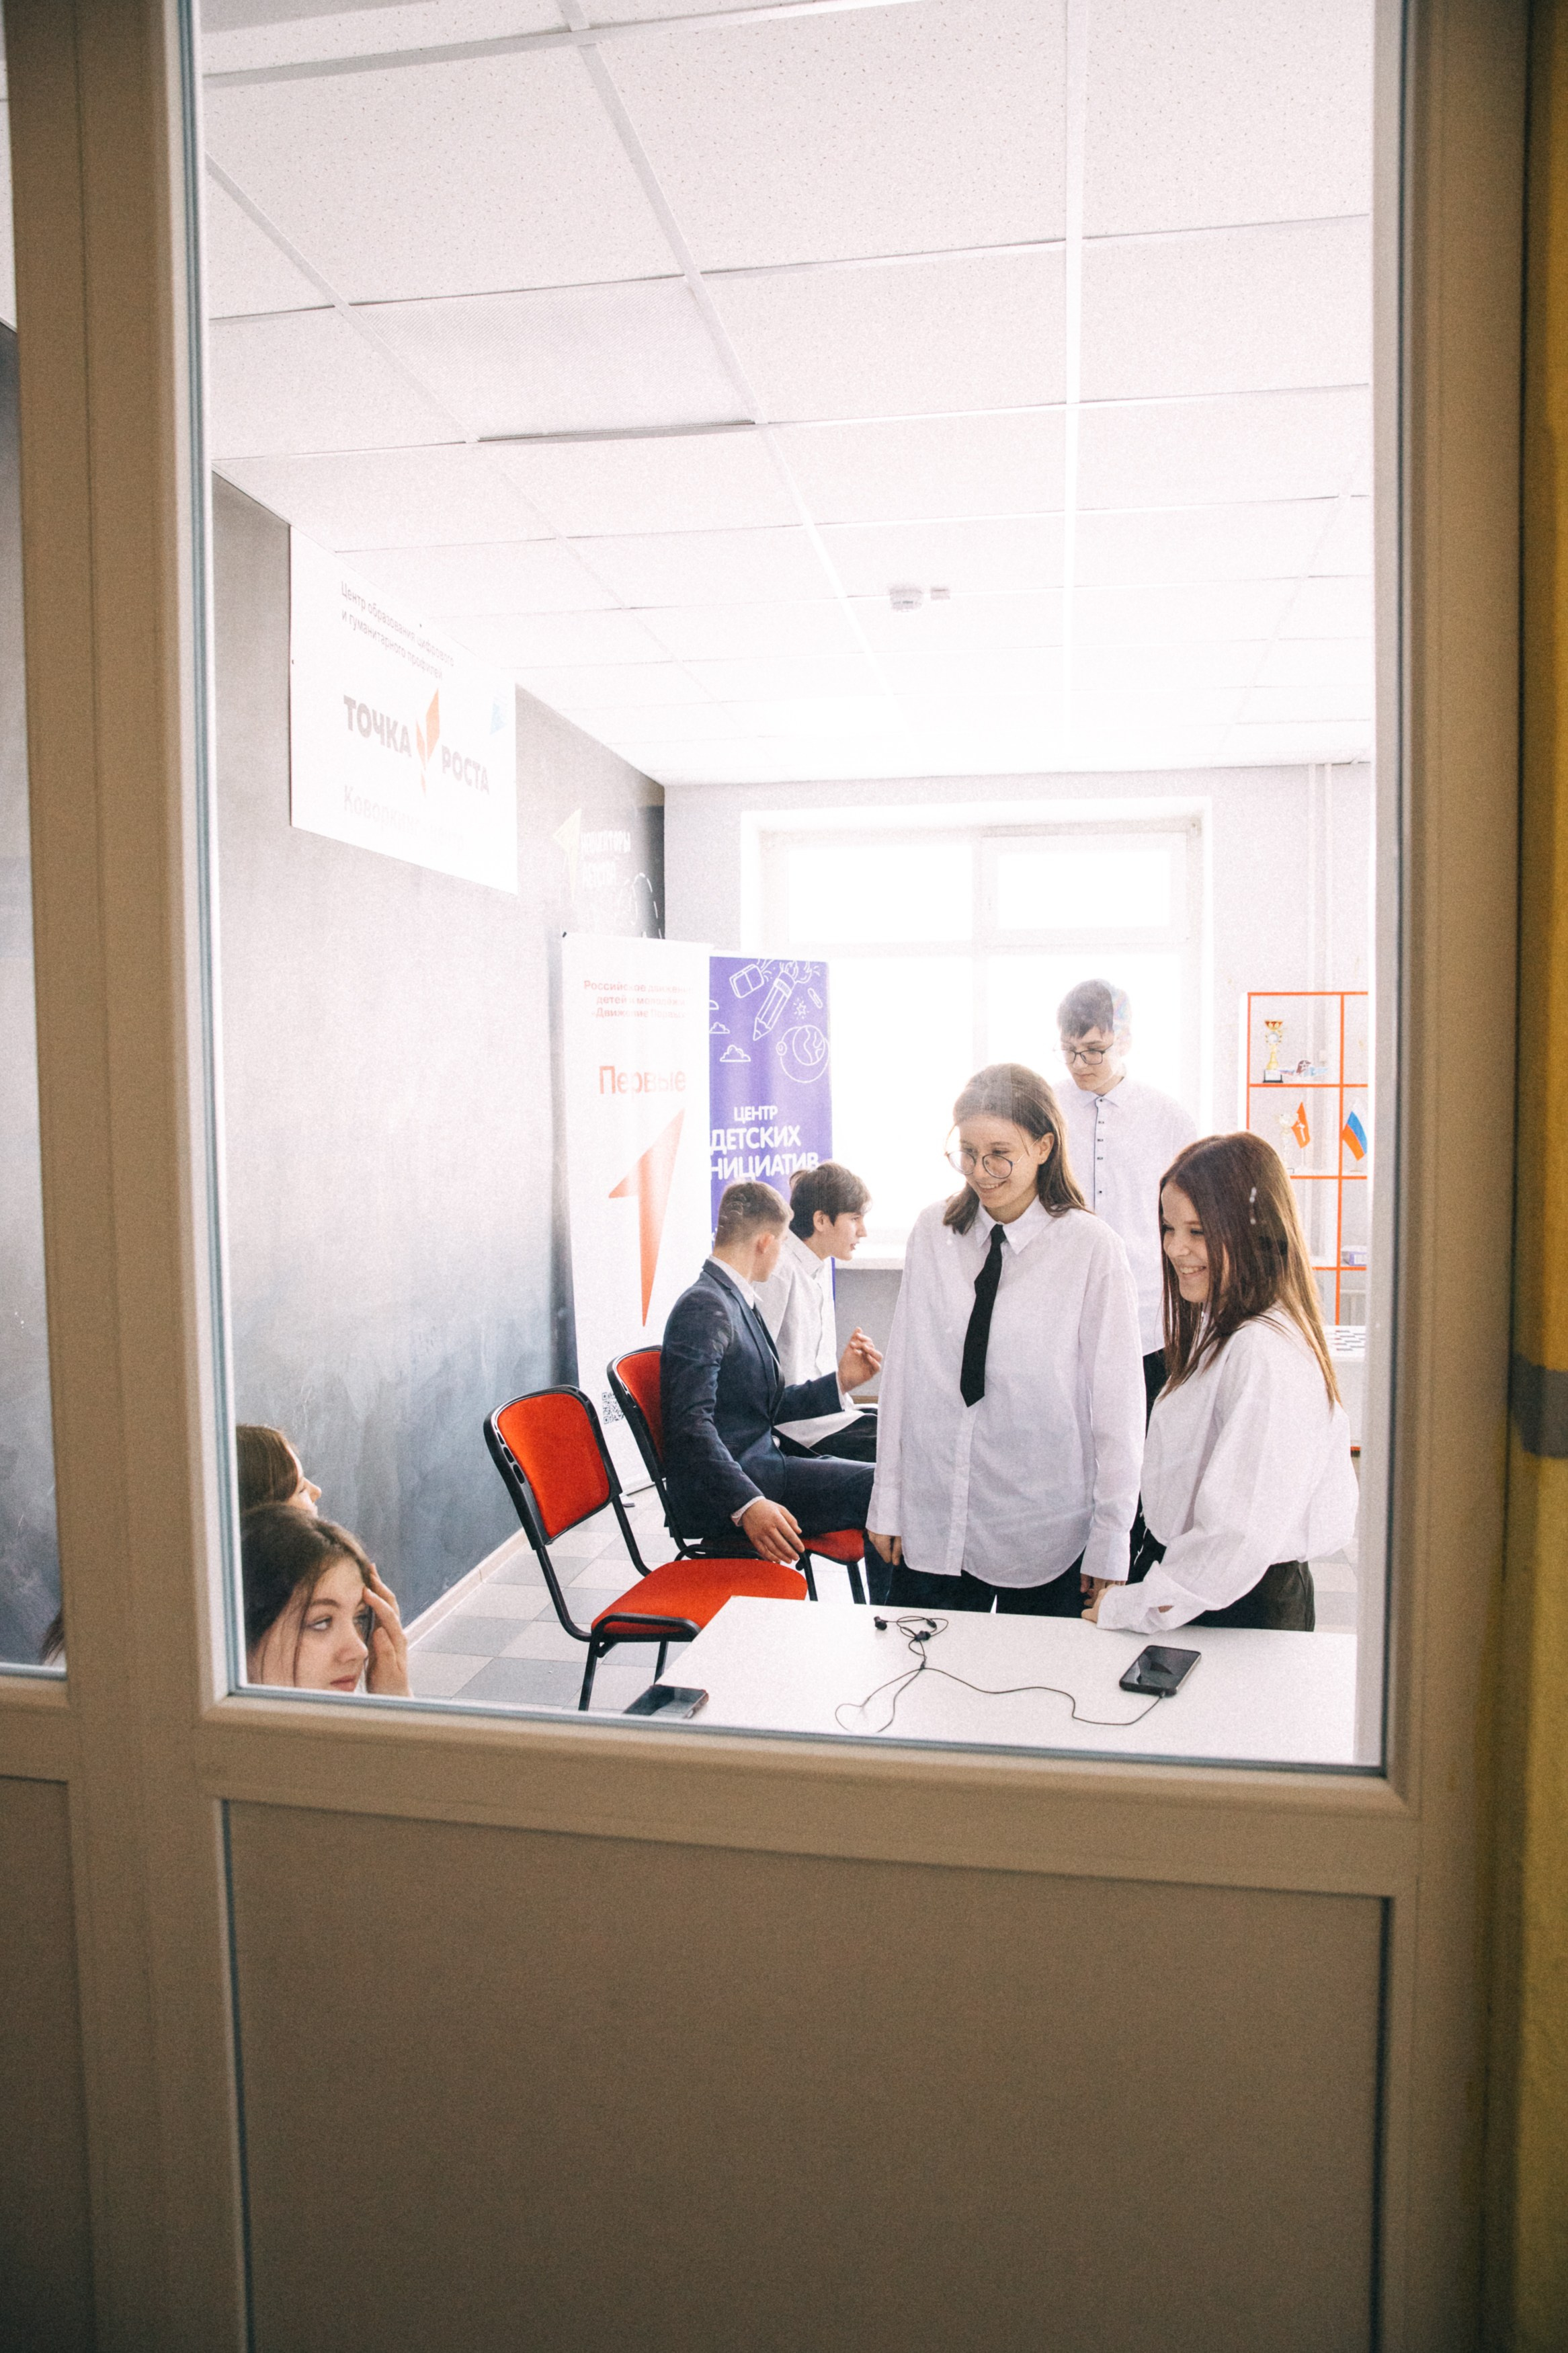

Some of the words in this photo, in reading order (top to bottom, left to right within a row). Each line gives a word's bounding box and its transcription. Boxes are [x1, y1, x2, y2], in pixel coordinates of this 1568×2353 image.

[341, 580, 366, 612] Центр
[368, 602, 416, 643] образования
[417, 636, 455, 668] цифрового
[341, 608, 347, 623] и
[349, 613, 407, 658] гуманитарного
[407, 651, 444, 680] профилей
[343, 694, 412, 758] ТОЧКА
[441, 744, 491, 795] РОСТА
[596, 995, 627, 1005] детей
[600, 1066, 686, 1102] Первые
[734, 1105, 778, 1124] ЦЕНТР
[710, 1125, 802, 1156] ДЕТСКИХ
[710, 1152, 819, 1181] НИЦИАТИВ
